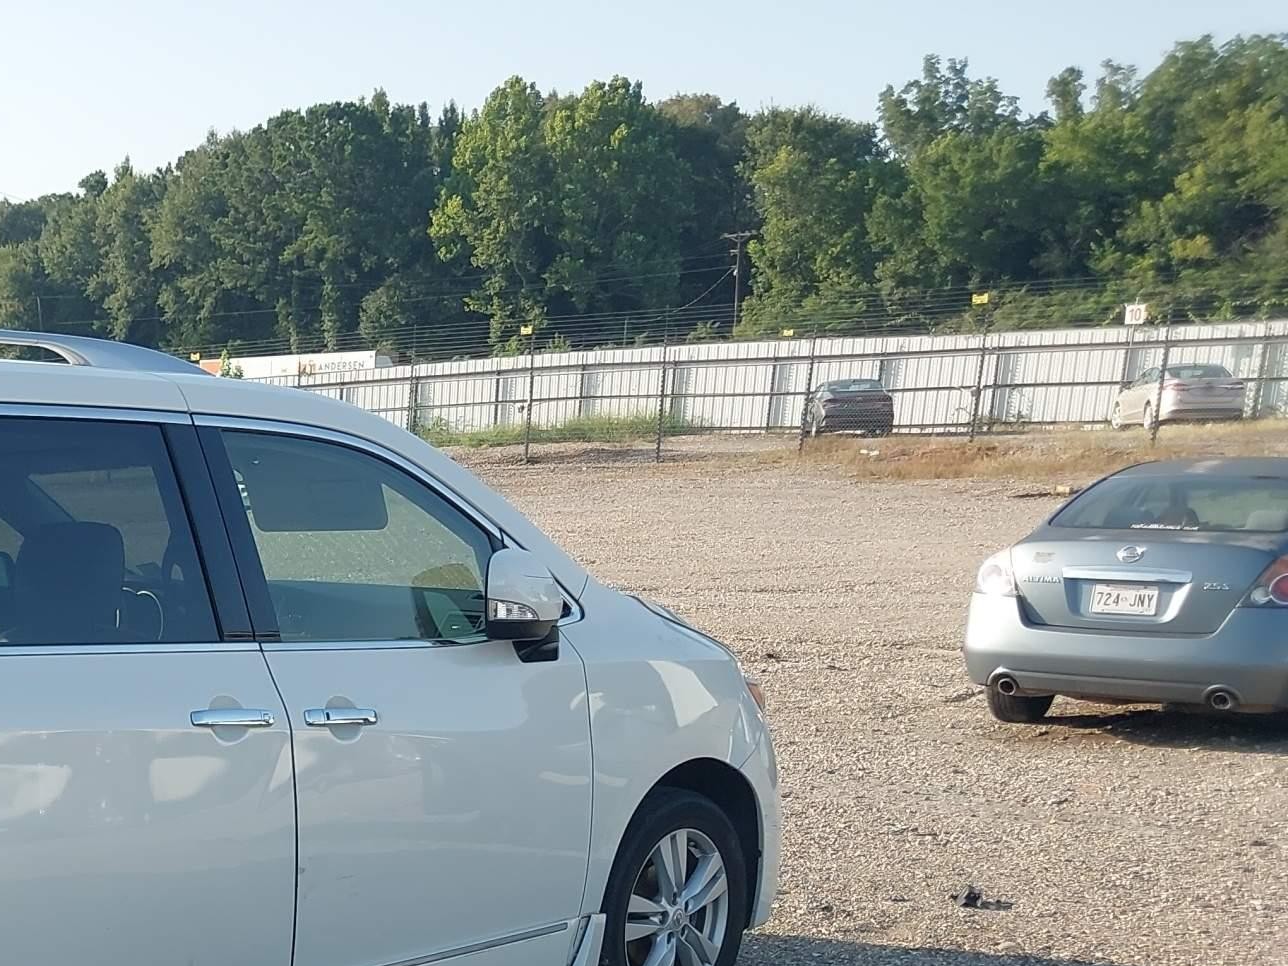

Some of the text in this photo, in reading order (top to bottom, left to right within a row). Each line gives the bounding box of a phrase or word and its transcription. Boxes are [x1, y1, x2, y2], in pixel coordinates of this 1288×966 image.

[1129, 308, 1142, 321] 10
[318, 360, 365, 371] ANDERSEN
[1096, 592, 1154, 608] 724 JNY
